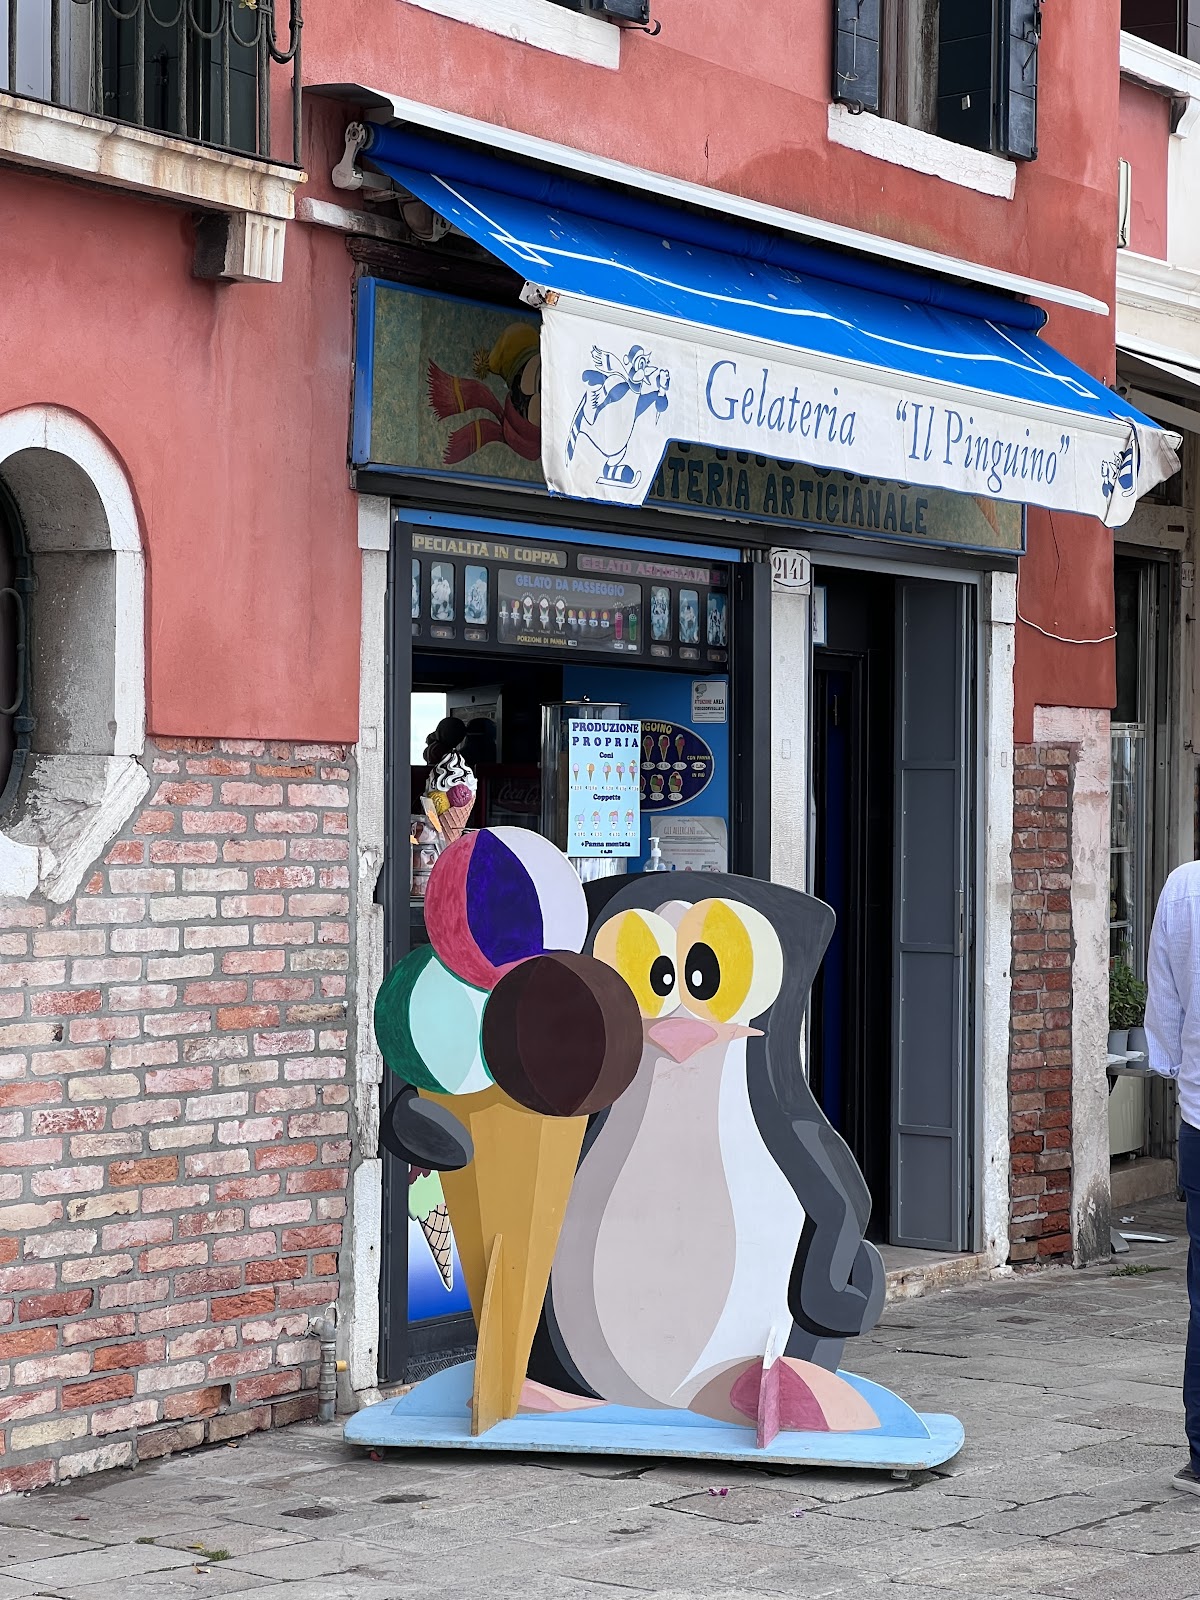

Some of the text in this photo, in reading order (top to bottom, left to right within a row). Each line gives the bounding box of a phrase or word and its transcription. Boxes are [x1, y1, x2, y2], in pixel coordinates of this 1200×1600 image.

[705, 359, 856, 447] Gelateria
[412, 534, 559, 566] PECIALITÀ IN COPPA
[581, 556, 632, 574] GELATO
[773, 556, 804, 580] 2141
[515, 574, 625, 597] GELATO DA PASSEGGIO
[516, 635, 542, 644] PORZIONE
[571, 722, 639, 734] PRODUZIONE
[571, 736, 639, 748] PROPRIA
[599, 751, 614, 759] Coni
[592, 793, 621, 802] Coppette
